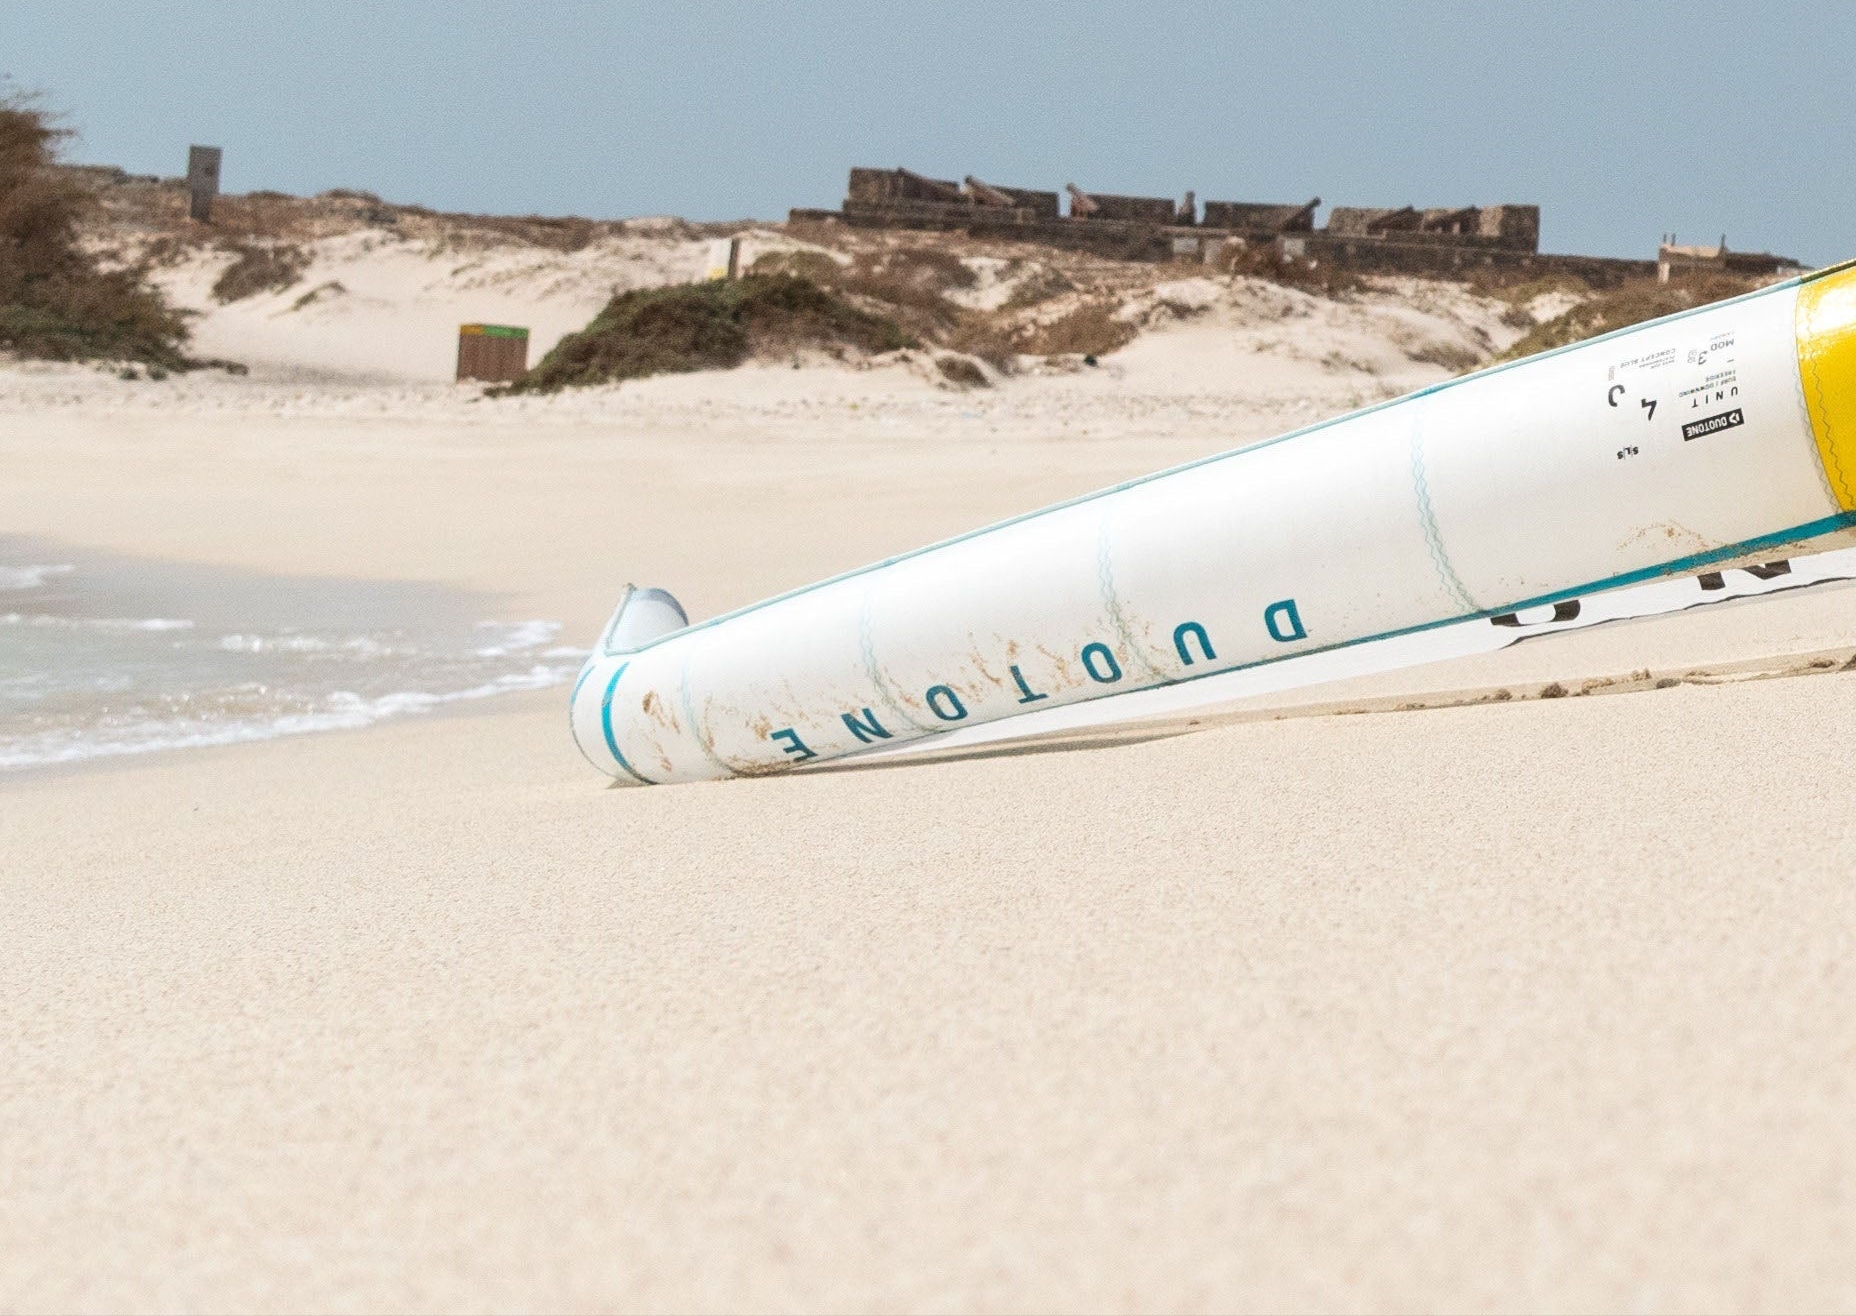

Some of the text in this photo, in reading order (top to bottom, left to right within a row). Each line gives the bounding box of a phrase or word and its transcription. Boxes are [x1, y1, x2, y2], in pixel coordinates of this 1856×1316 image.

[1691, 386, 1739, 408] UNIT
[1685, 416, 1728, 437] DUOTONE
[771, 598, 1308, 764] DUOTONE
